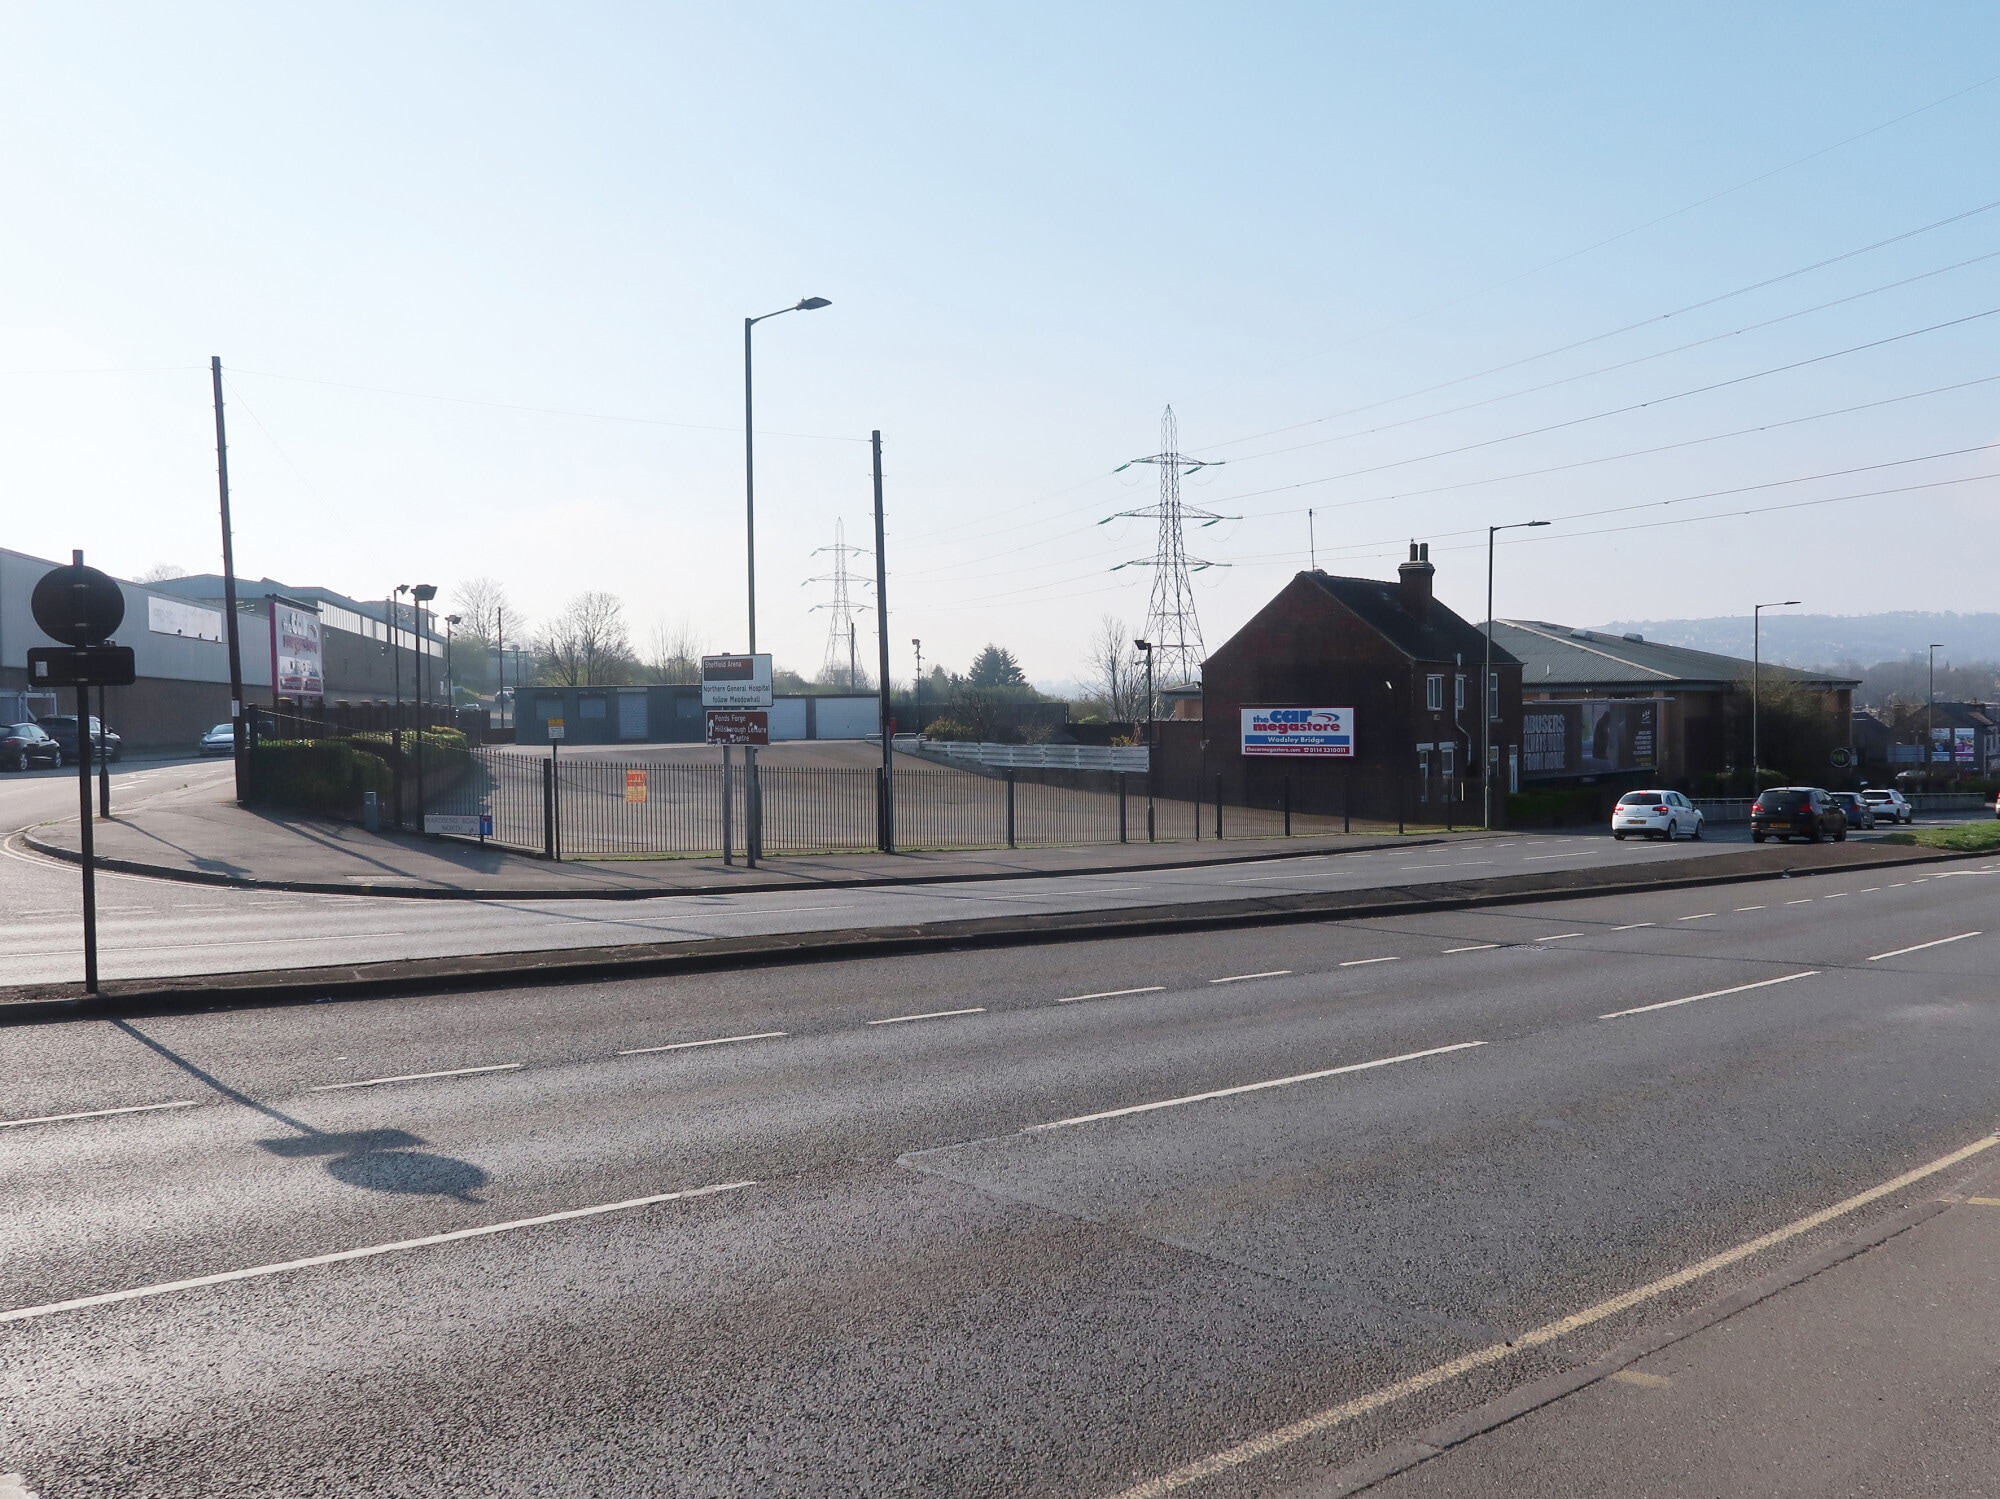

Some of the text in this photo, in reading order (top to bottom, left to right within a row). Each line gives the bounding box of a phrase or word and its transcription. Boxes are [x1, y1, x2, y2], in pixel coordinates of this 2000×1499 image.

[704, 660, 742, 669] Sheffield Arena
[703, 684, 771, 693] Northern General Hospital
[729, 695, 761, 703] Meadowhall
[714, 714, 746, 723] Ponds Forge
[1253, 710, 1312, 723] the car
[1253, 722, 1340, 734] megastore
[1523, 714, 1565, 734] ABUSERS
[1267, 736, 1325, 744] Wadsley Bridge
[462, 817, 479, 825] ROAD
